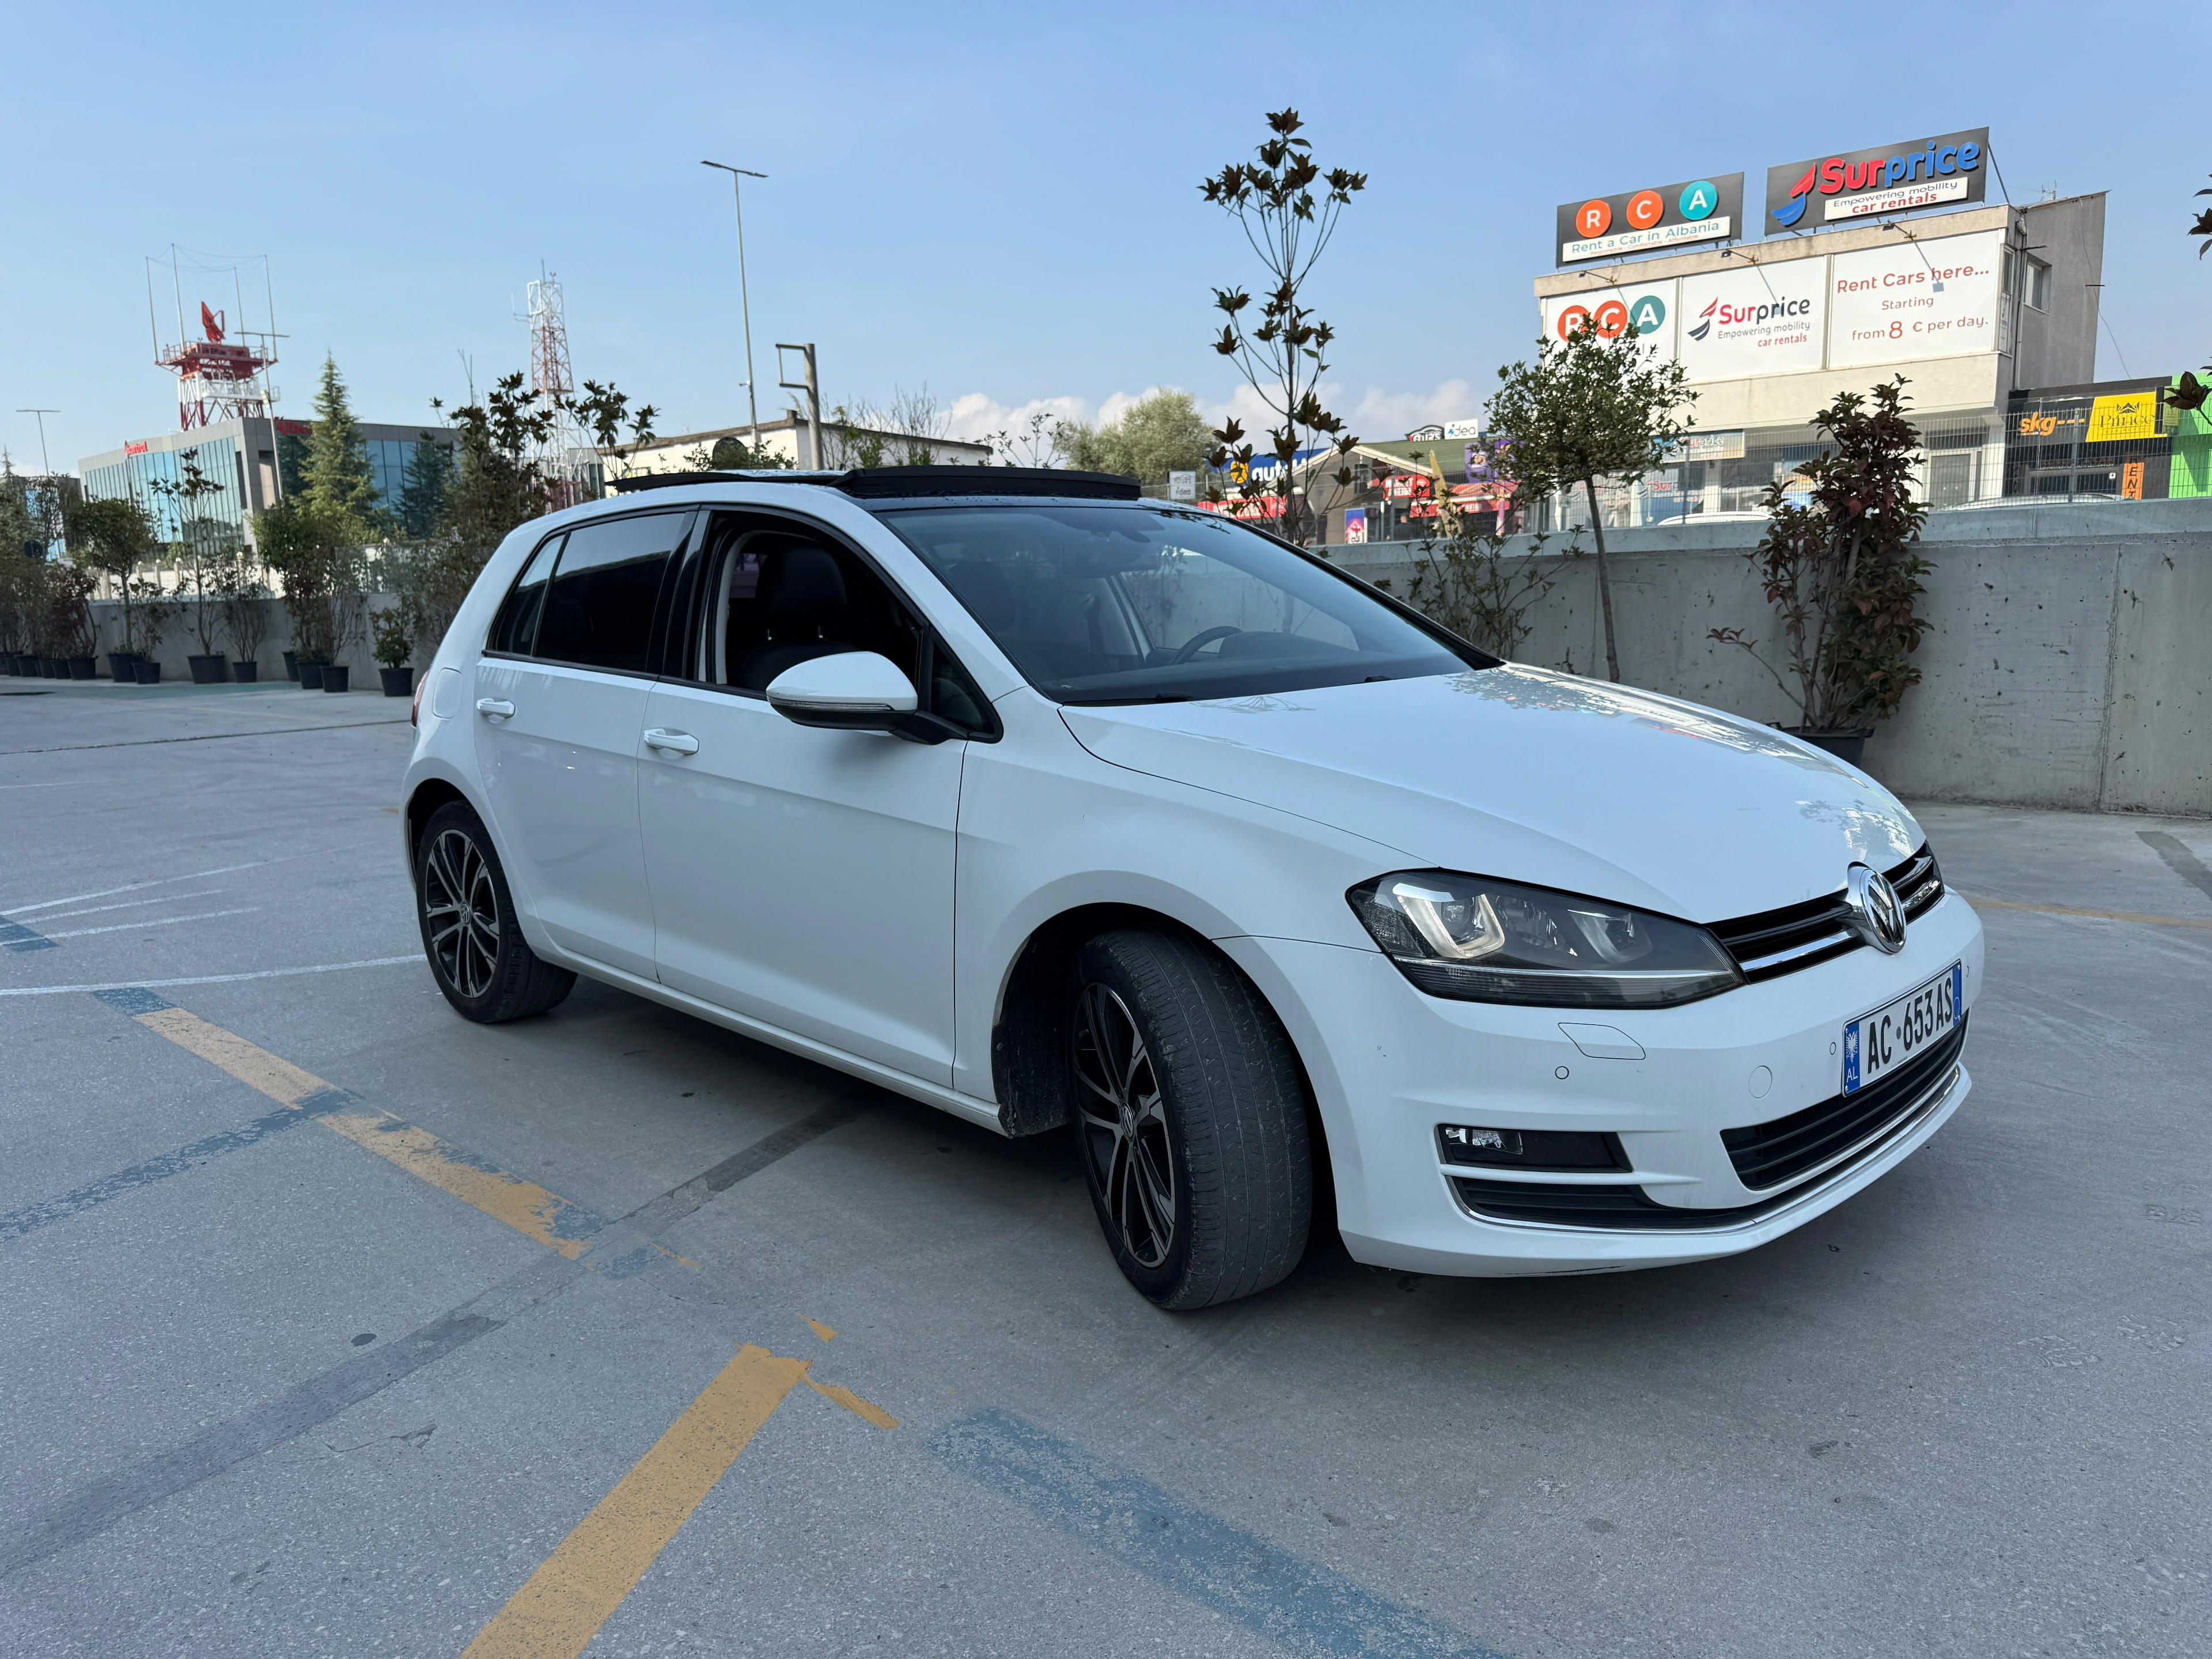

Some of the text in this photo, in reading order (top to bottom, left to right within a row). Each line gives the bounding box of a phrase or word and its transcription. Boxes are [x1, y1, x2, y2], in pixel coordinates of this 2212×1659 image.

[1819, 139, 1980, 194] Surprice
[1834, 181, 1957, 208] Empowering mobility
[1852, 192, 1937, 214] car rentals
[1572, 221, 1719, 253] Rent a Car in Albania
[1837, 266, 1989, 293] Rent Cars here...
[1718, 296, 1810, 325] Surprice
[1881, 297, 1934, 310] Starting
[1718, 321, 1810, 339] Empowering mobility
[1852, 316, 1988, 340] from 8 € per day.
[1758, 333, 1807, 347] car rentals
[2100, 415, 2155, 427] Prince
[1846, 1066, 1858, 1083] AL
